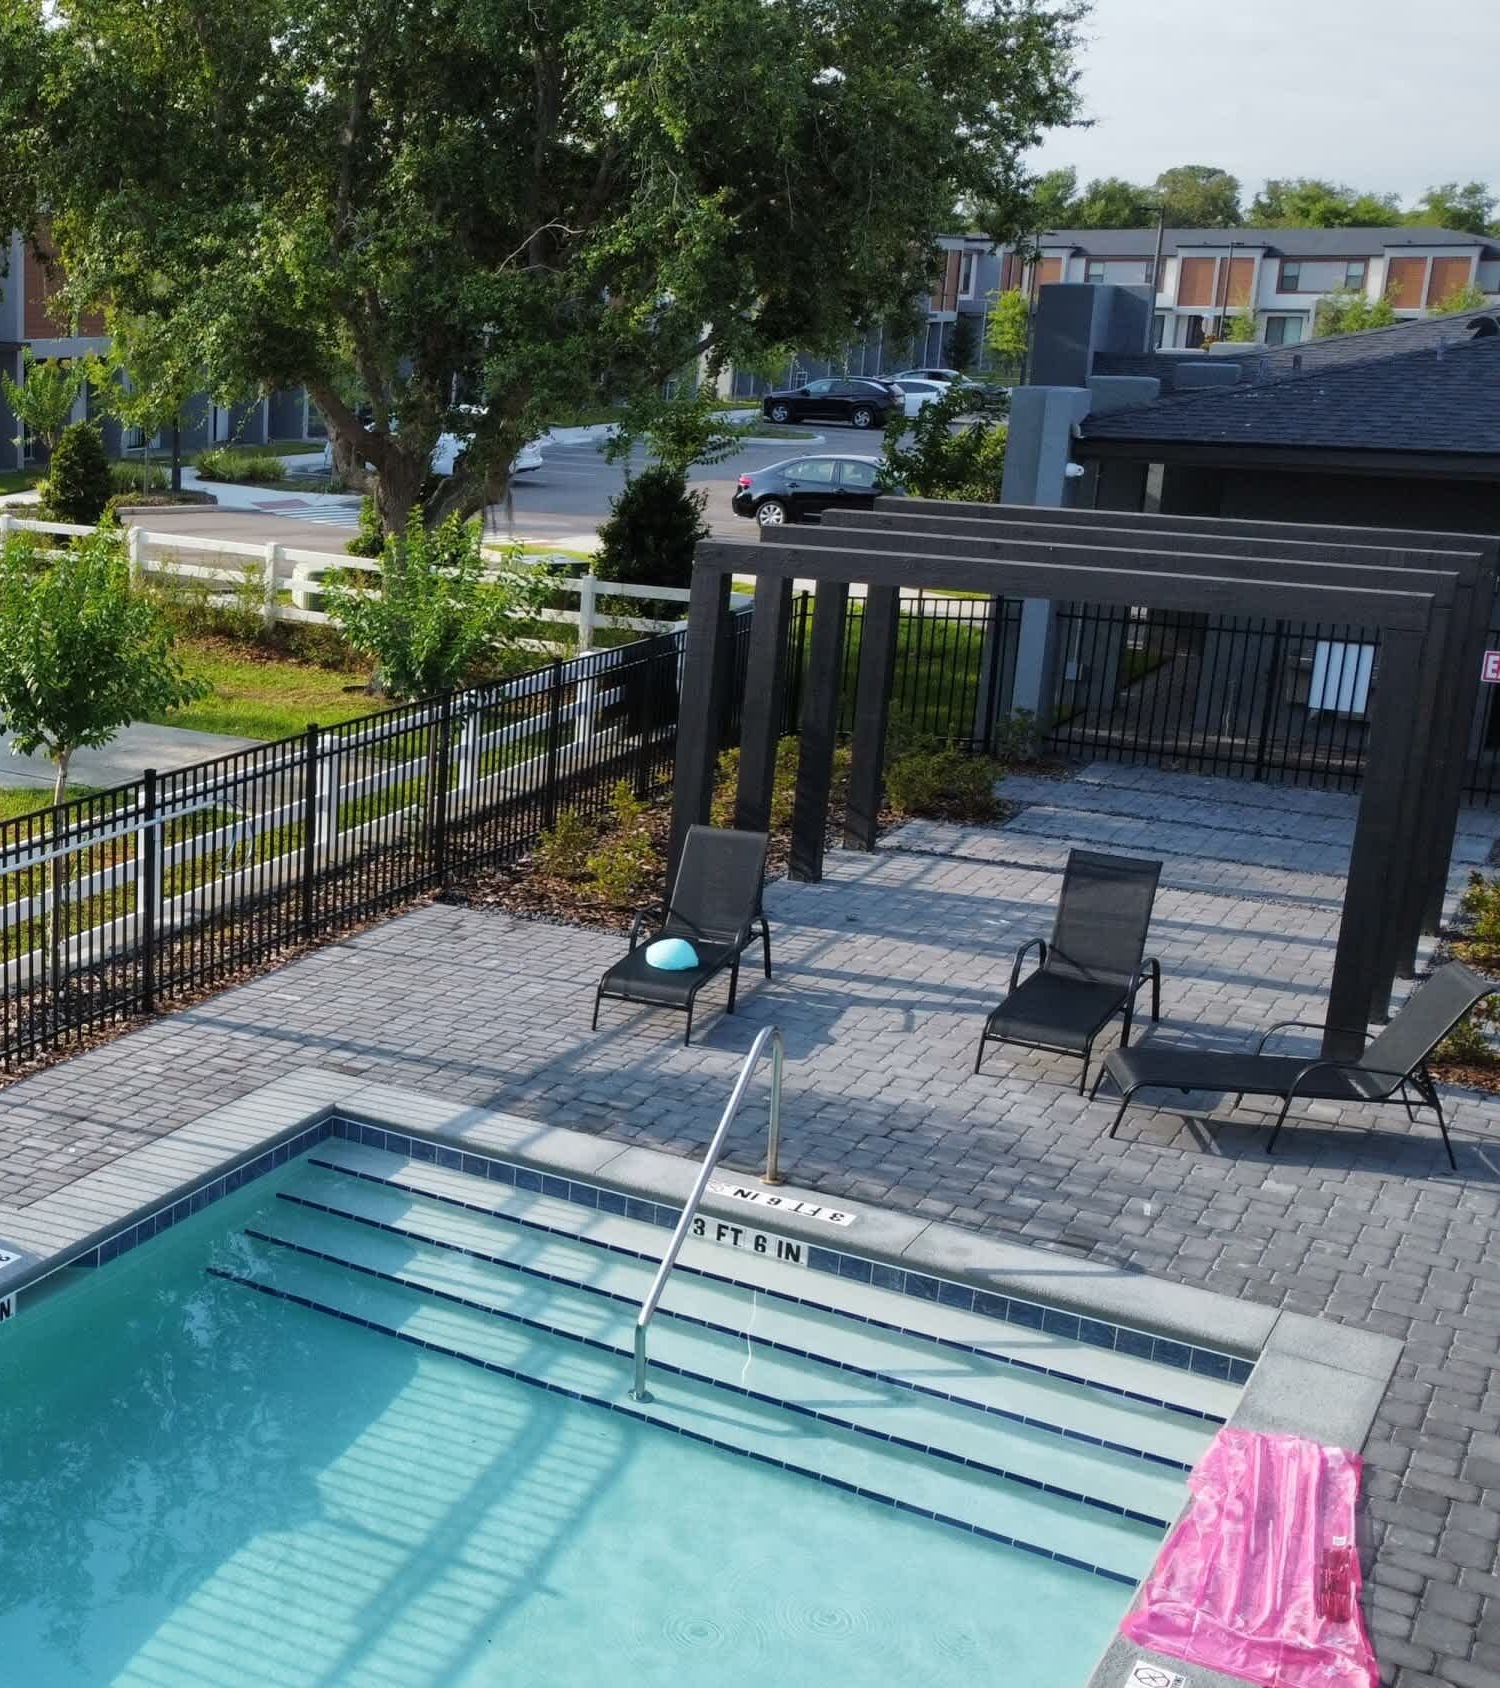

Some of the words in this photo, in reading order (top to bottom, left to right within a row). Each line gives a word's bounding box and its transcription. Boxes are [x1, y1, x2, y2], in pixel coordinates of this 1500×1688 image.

[767, 1197, 782, 1206] 6
[828, 1213, 845, 1222] 3
[693, 1217, 706, 1236] 3
[754, 1234, 767, 1253] 6
